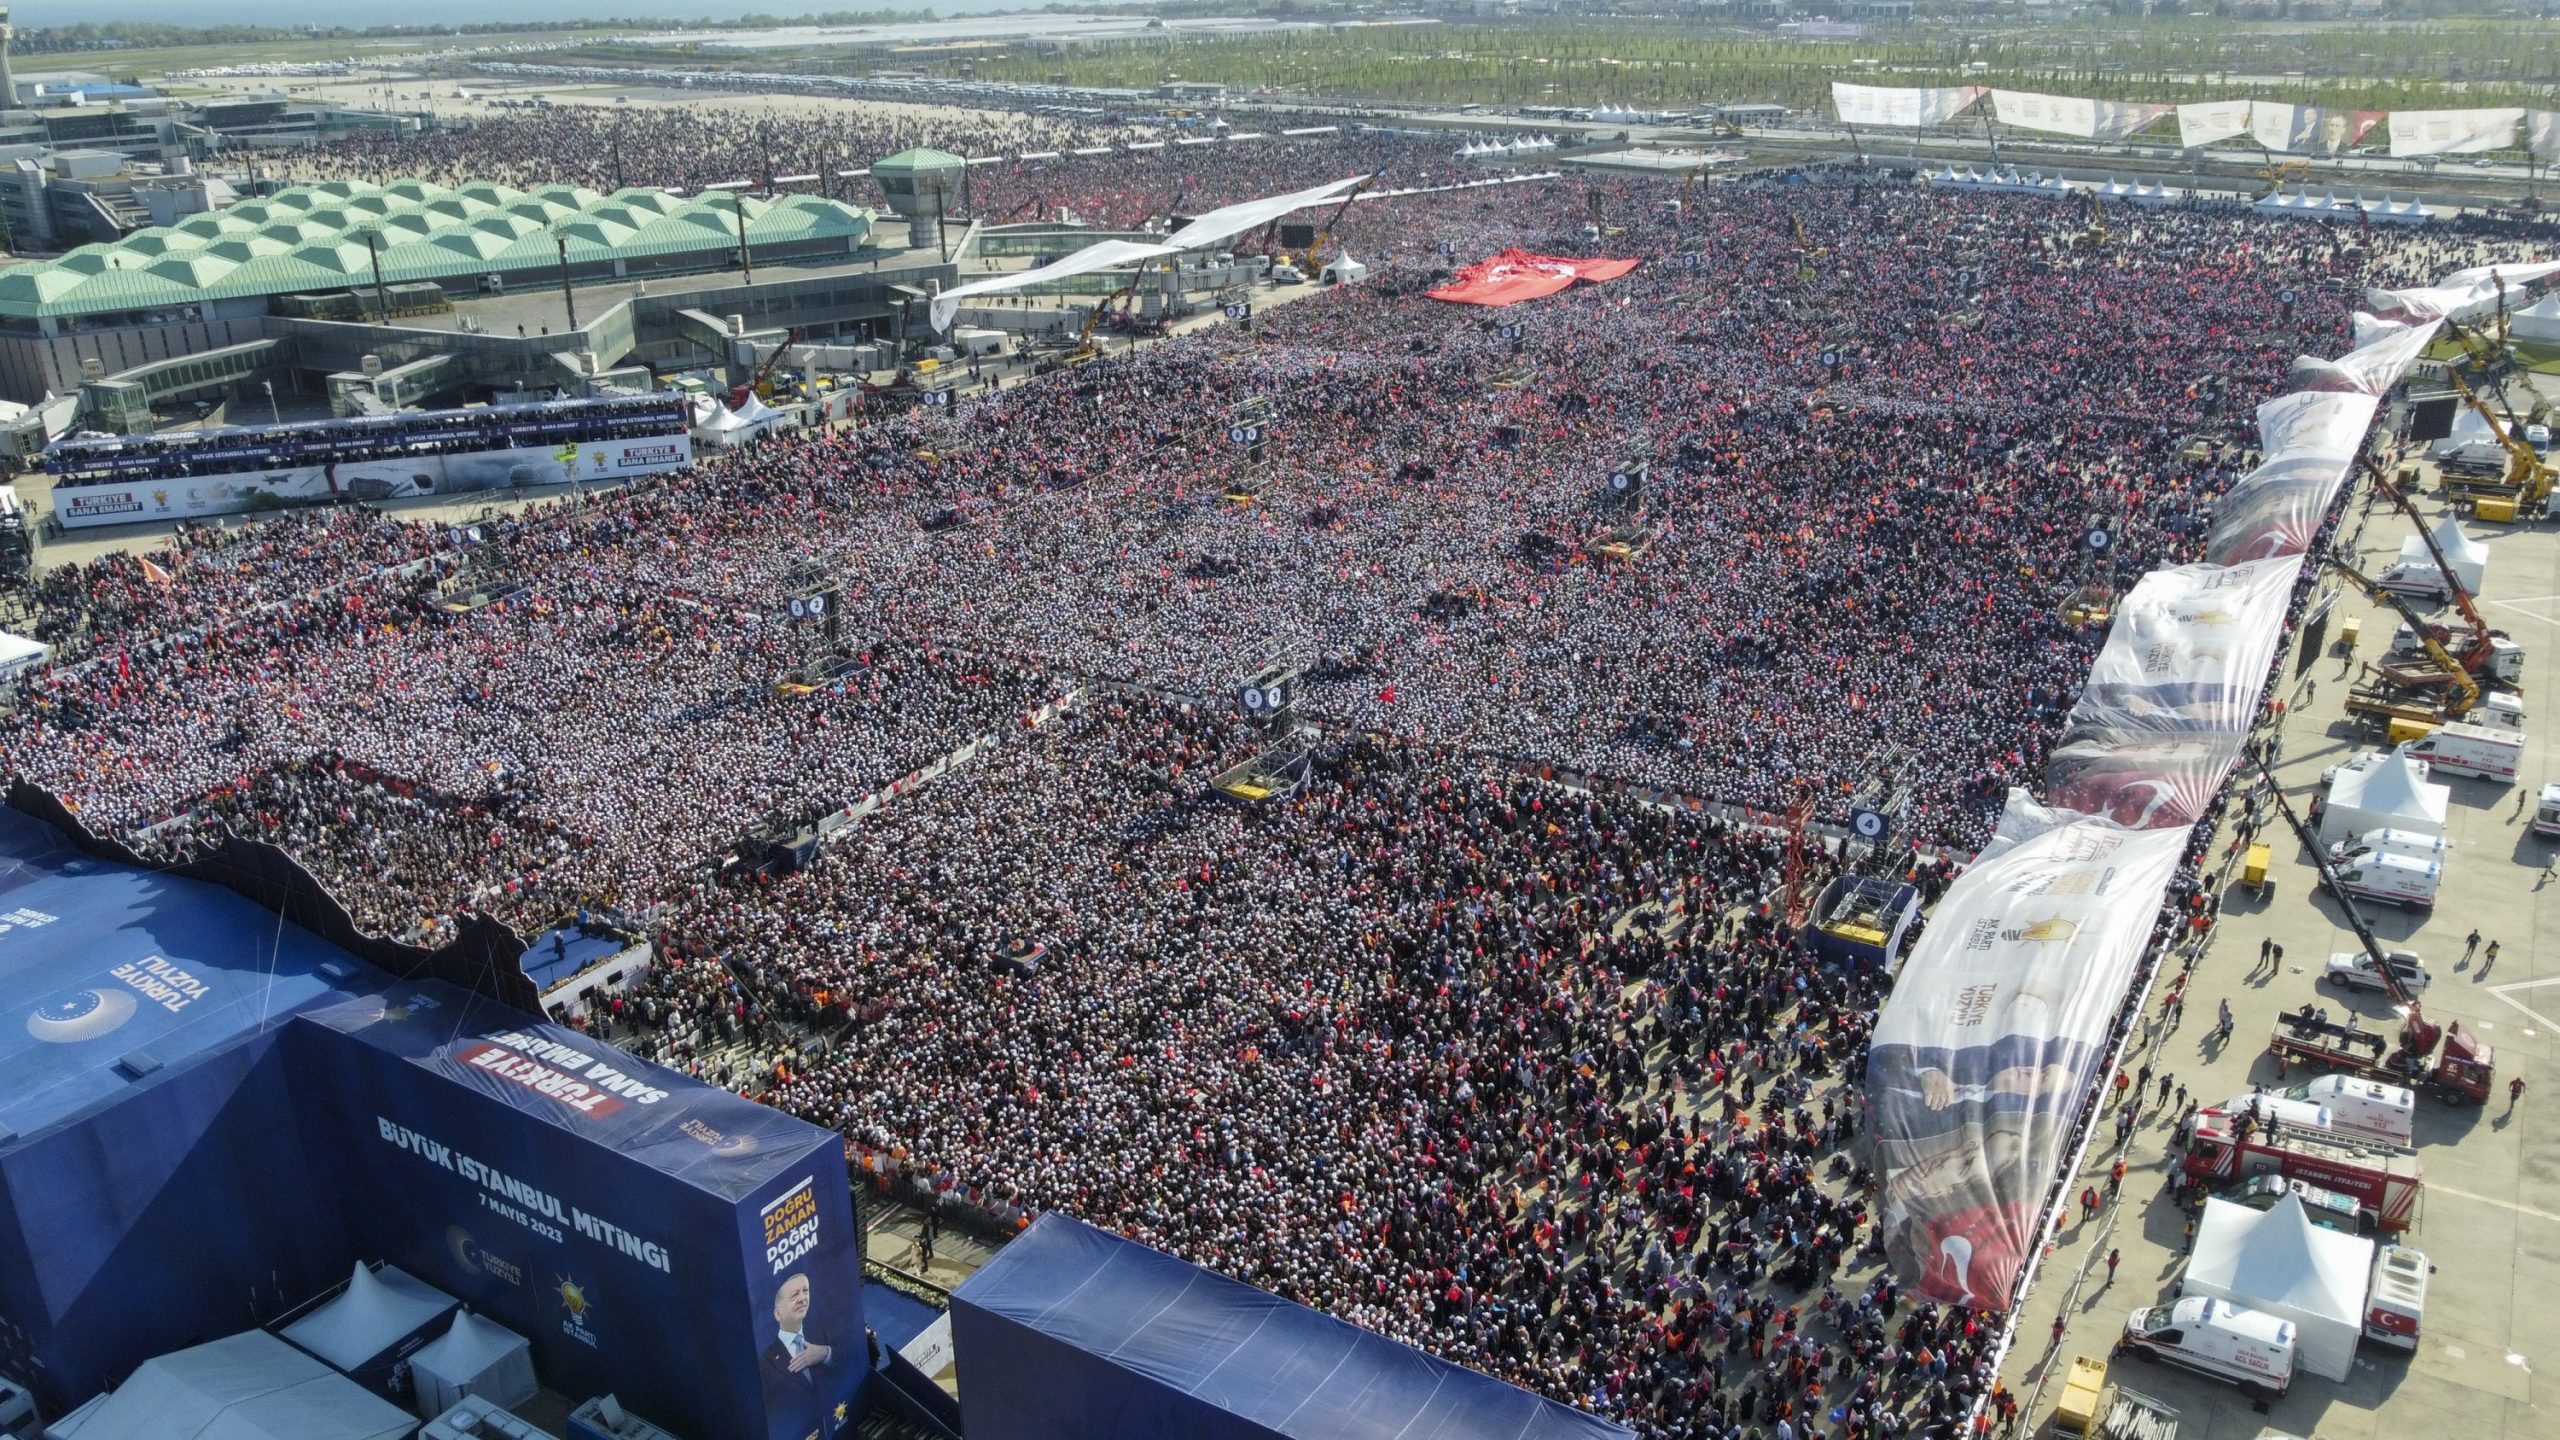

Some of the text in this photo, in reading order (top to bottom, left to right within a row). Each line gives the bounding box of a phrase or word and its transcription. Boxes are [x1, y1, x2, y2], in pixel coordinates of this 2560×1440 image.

[619, 454, 683, 467] SANA EMANET
[627, 445, 672, 457] TÜRKİYE
[69, 506, 100, 517] SANA
[100, 502, 142, 514] EMANET
[77, 493, 128, 506] TÜRKİYE
[1864, 818, 1874, 830] 4
[1979, 918, 2000, 951] AK PARTİ
[110, 963, 191, 1013] TÜRKİYE
[136, 955, 210, 1000] YÜZYILI
[1967, 982, 1998, 1028] TÜRKİYE
[469, 1048, 608, 1112] TÜRKİYE
[585, 1062, 669, 1105] SANA
[377, 1116, 671, 1273] BÜYÜK İSTANBUL MİTİNGİ
[2295, 1167, 2332, 1182] İSTANBUL
[2334, 1175, 2372, 1190] İTFAİYESİ
[478, 1193, 564, 1244] 7 MAYIS 2023
[764, 1186, 813, 1229] DOĞRU
[765, 1200, 816, 1245] ZAMAN
[766, 1215, 819, 1263] DOĞRU
[773, 1231, 818, 1276] ADAM
[480, 1249, 522, 1278] TÜRKİYE
[563, 1320, 597, 1342] AK PARTİ
